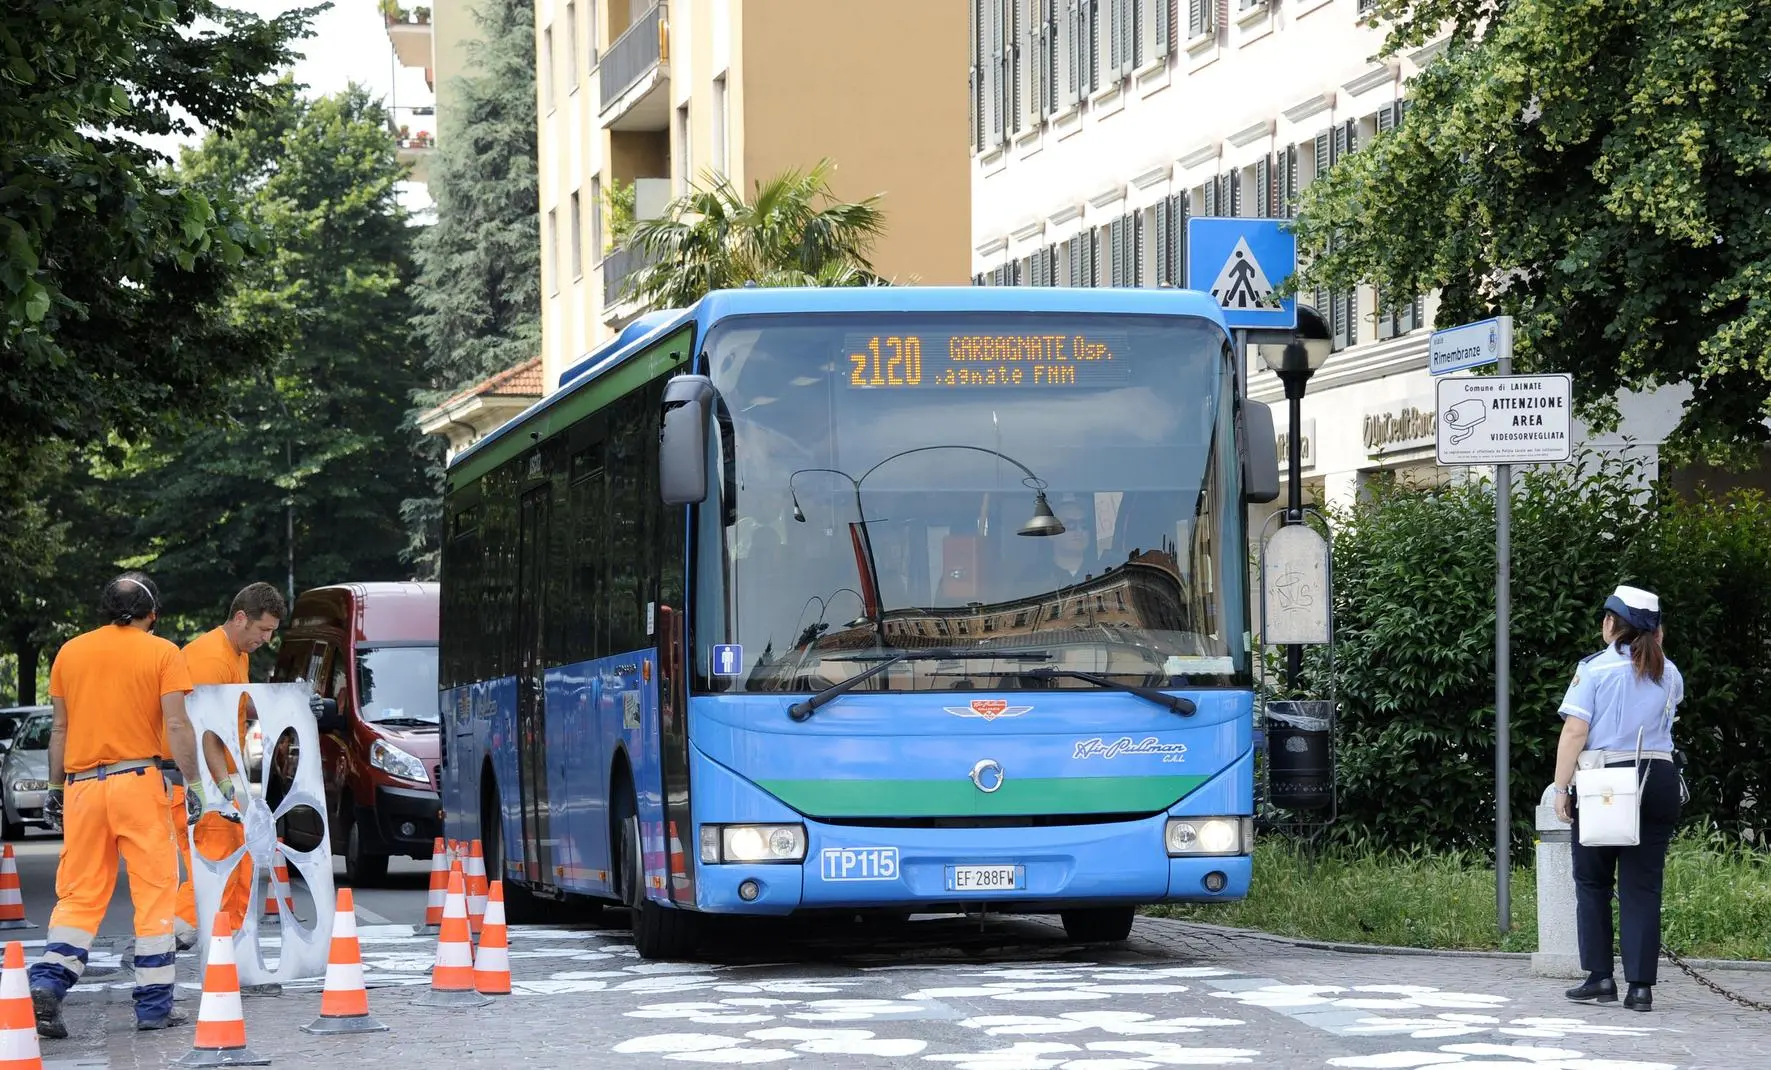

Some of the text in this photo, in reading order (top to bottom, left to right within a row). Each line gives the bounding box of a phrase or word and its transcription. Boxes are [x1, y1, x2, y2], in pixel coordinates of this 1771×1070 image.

[950, 335, 1112, 361] GARBAGNATE Osp.
[1433, 345, 1481, 366] Rimembranze
[850, 336, 921, 385] z120
[935, 365, 1075, 385] agnate FNM
[1464, 382, 1542, 392] Comune di LAINATE
[1492, 397, 1563, 410] ATTENZIONE
[1512, 415, 1543, 426] AREA
[1490, 432, 1565, 441] VIDEOSORVEGLIATA
[1073, 737, 1187, 759] Air Pullman
[825, 850, 895, 878] TP115
[957, 871, 972, 886] EF
[976, 870, 1014, 886] 288FW
